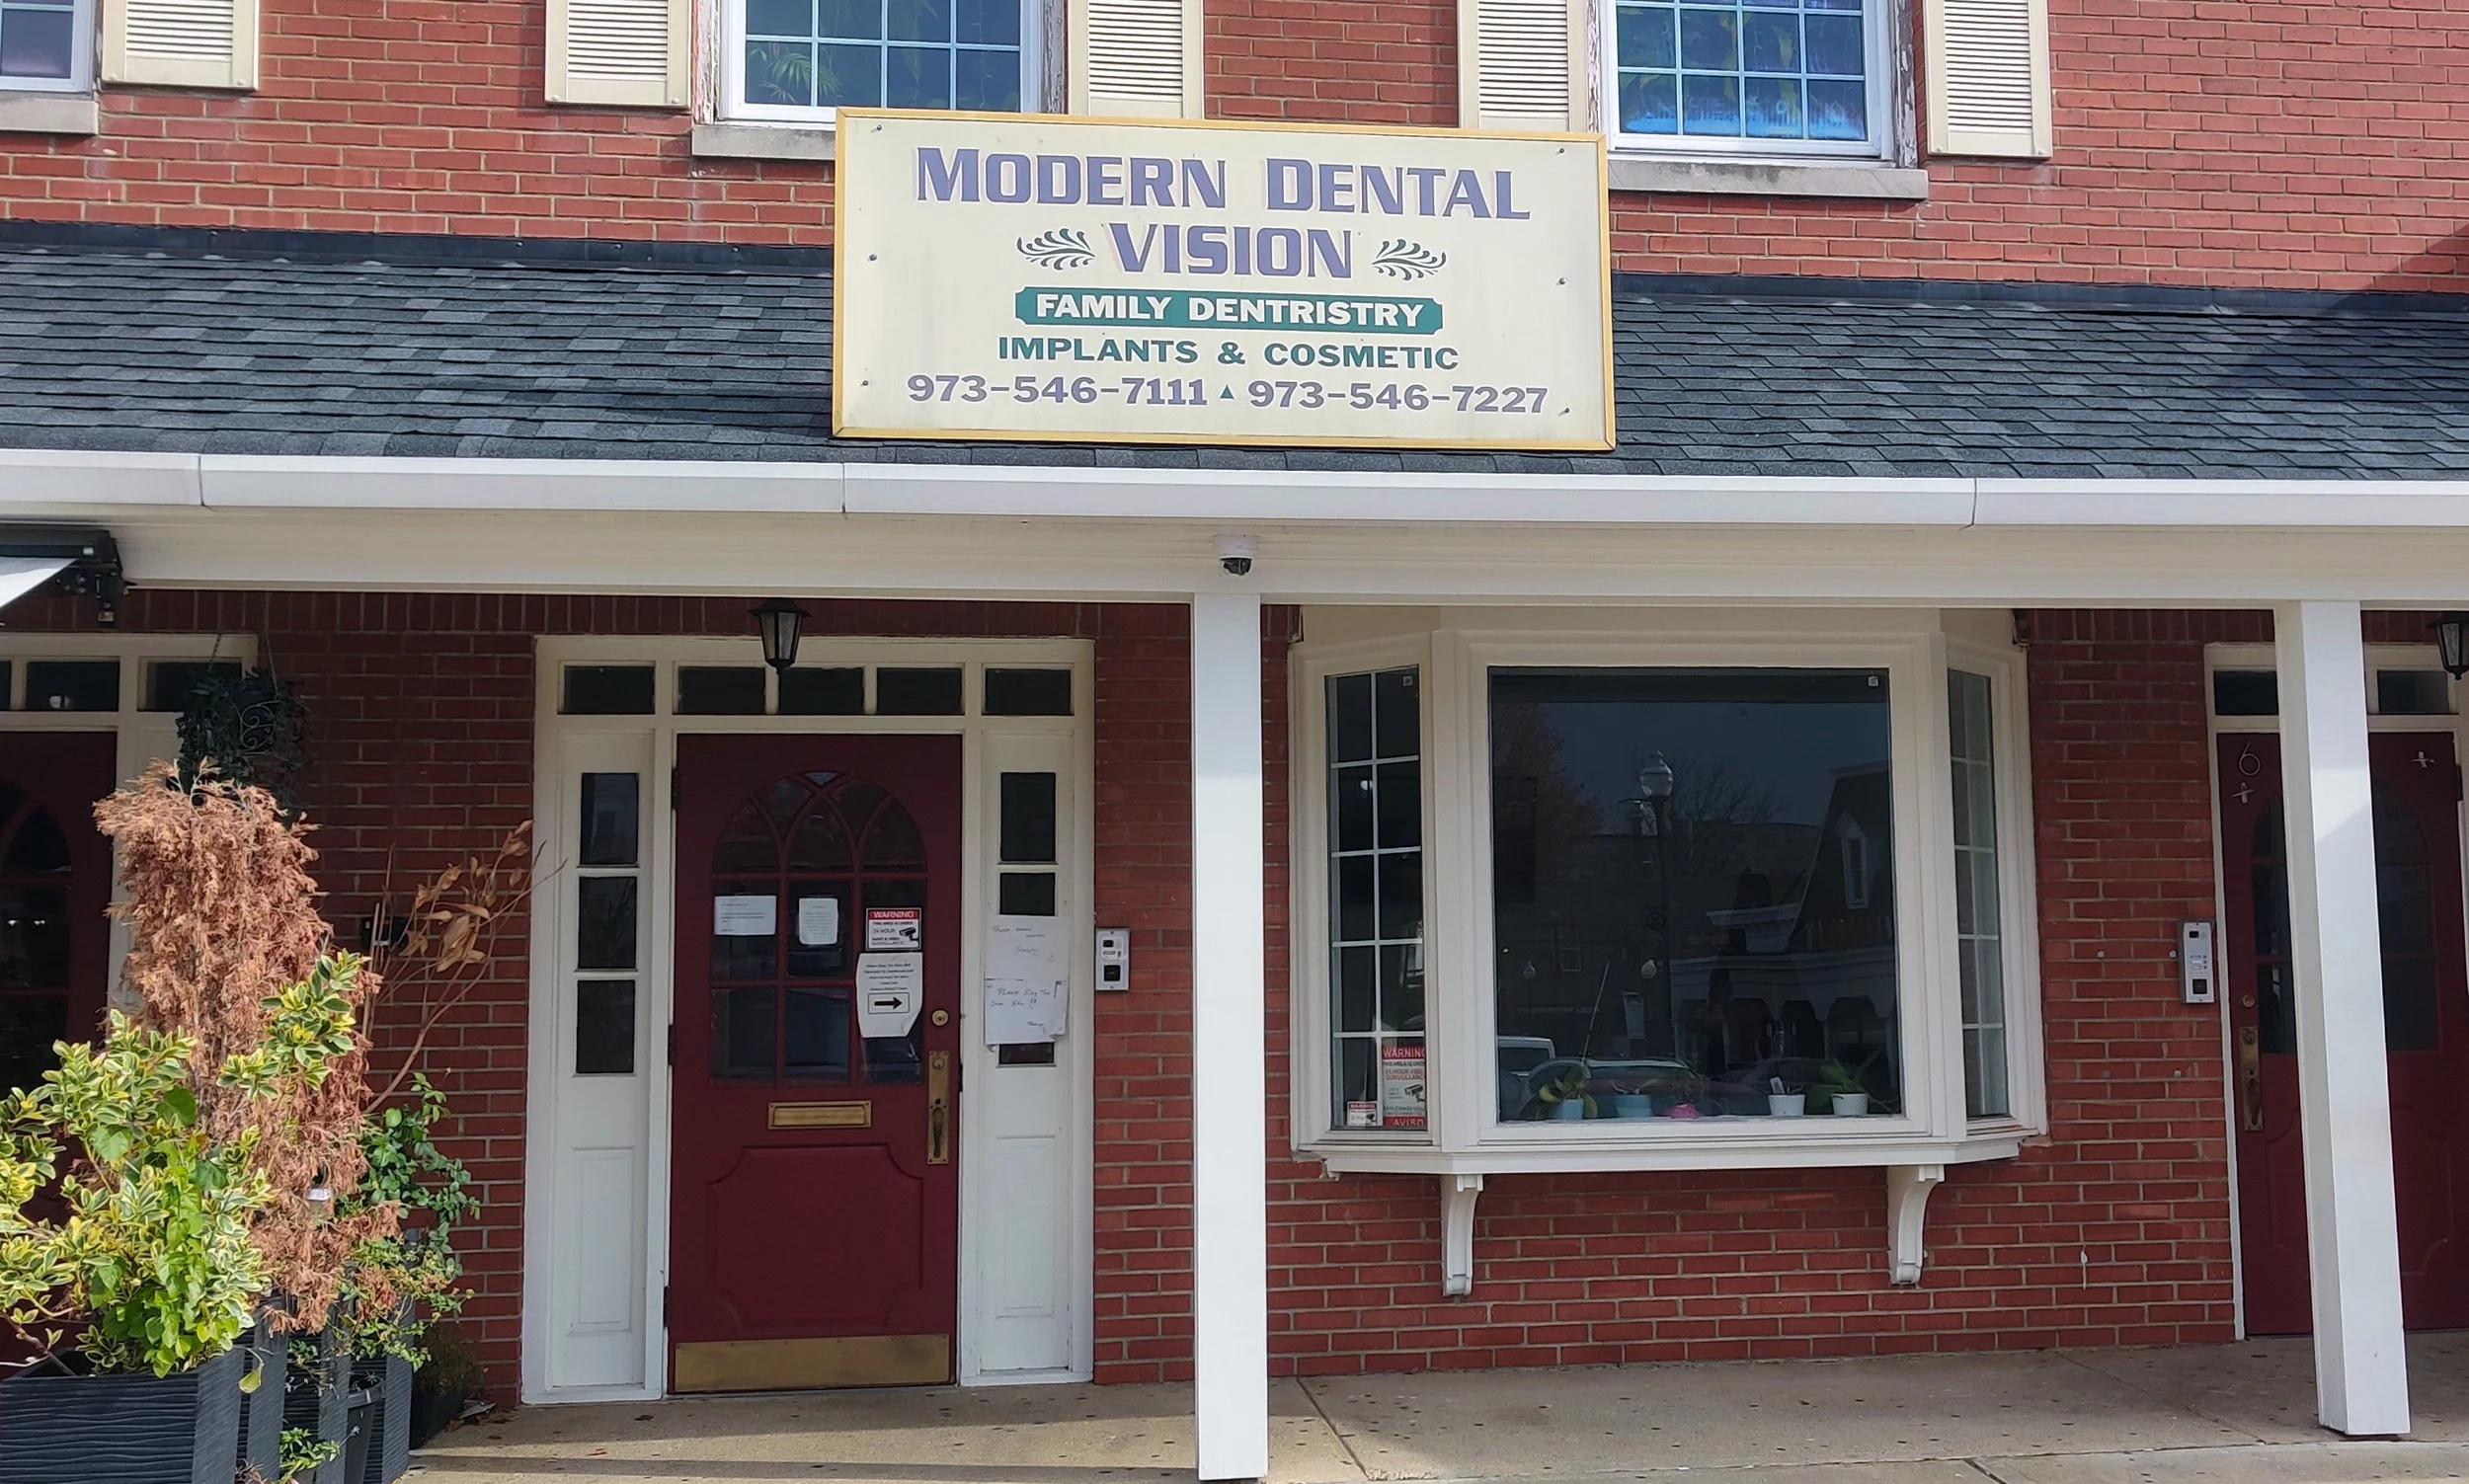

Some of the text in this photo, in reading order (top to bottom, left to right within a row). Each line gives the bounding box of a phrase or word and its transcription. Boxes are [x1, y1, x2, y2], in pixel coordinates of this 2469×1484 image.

[916, 147, 1531, 219] MODERN DENTAL
[1109, 223, 1351, 278] VISION
[1037, 294, 1423, 328] FAMILY DENTRISTRY
[999, 337, 1459, 370] IMPLANTS & COSMETIC
[907, 374, 1549, 414] 973-546-7111 973-546-7227
[2238, 741, 2261, 776] 6
